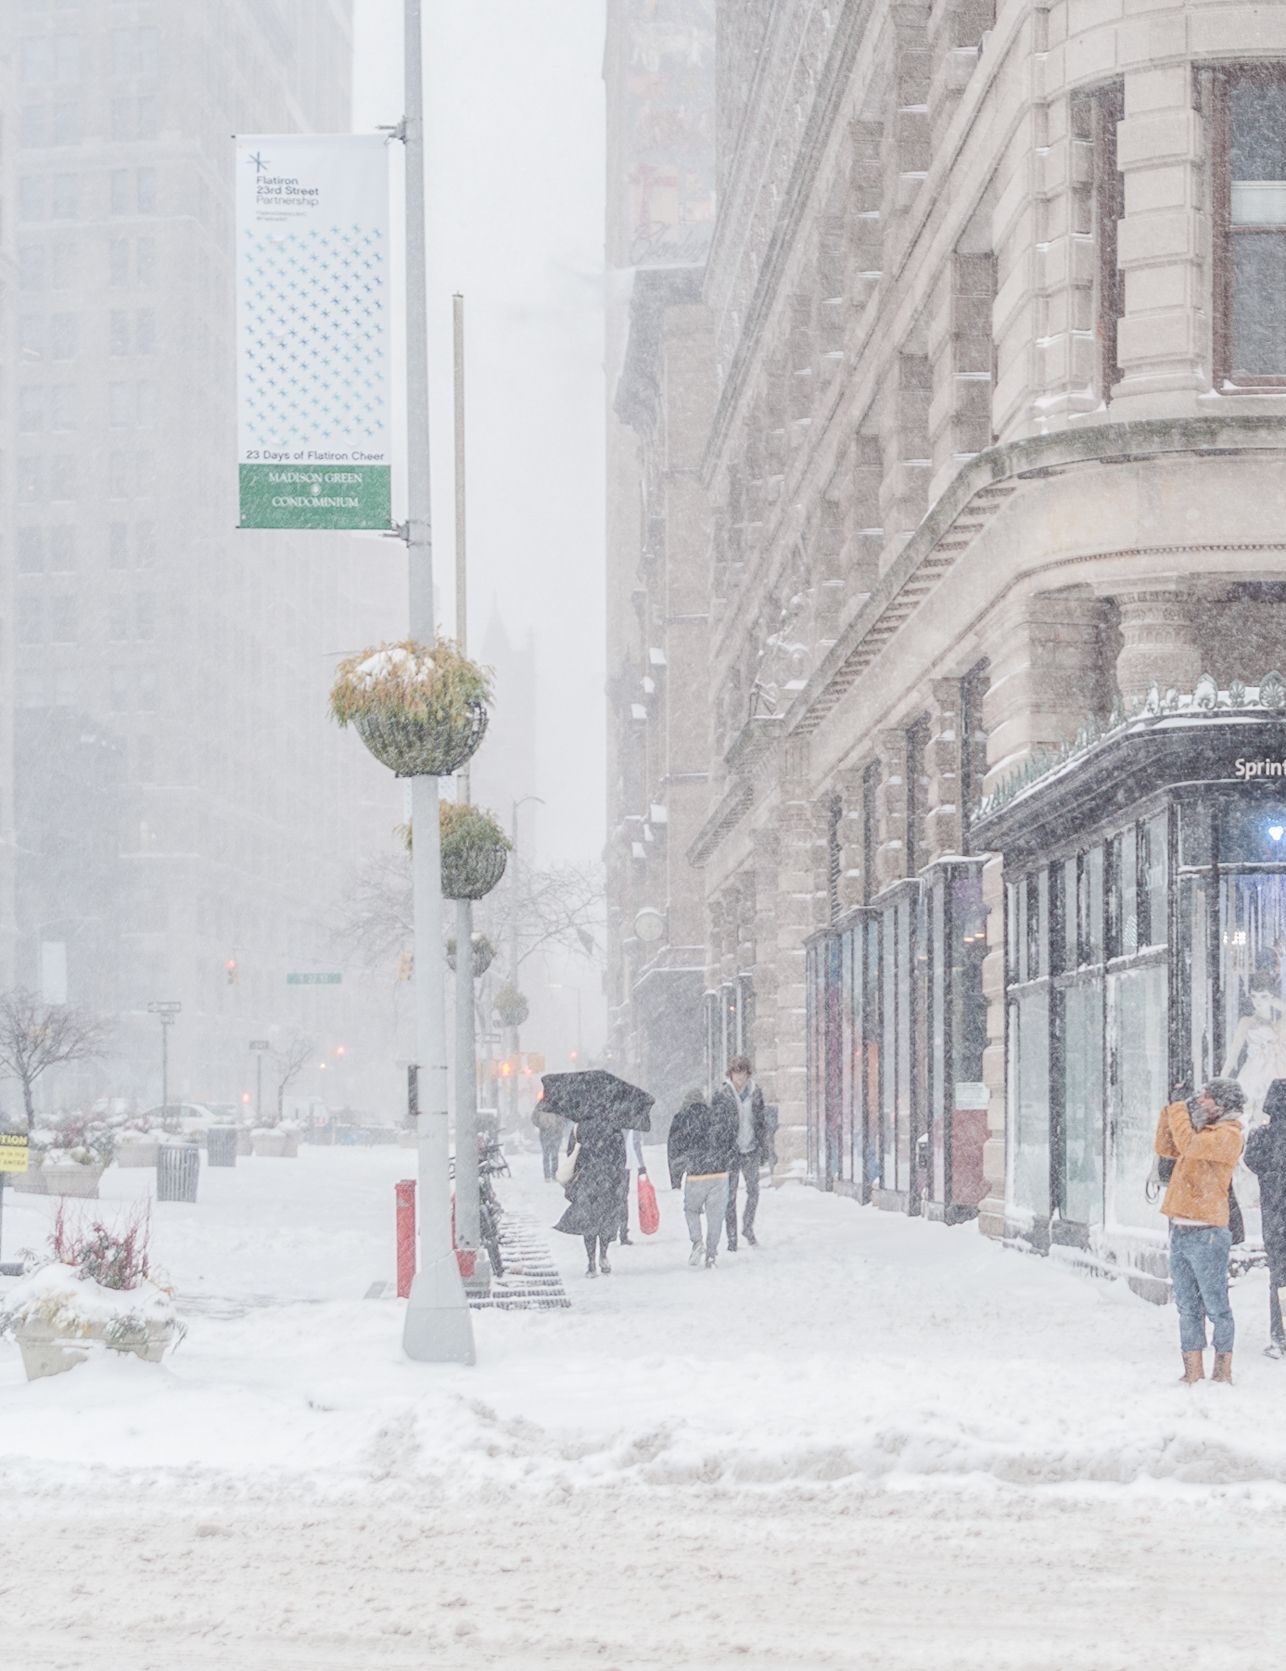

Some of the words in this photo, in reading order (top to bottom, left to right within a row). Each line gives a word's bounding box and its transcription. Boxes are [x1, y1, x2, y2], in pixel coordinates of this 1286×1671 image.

[256, 176, 298, 185] Flatiron
[256, 186, 282, 195] 23rd
[284, 186, 319, 196] Street
[256, 195, 319, 207] Partnership
[246, 450, 259, 460] 23
[263, 450, 290, 461] Days
[294, 450, 304, 460] of
[308, 450, 348, 460] Flatiron
[352, 450, 384, 460] Cheer
[269, 472, 323, 483] MADISON
[325, 472, 363, 483] GREEN
[271, 496, 359, 507] CONDOMINIUM
[0, 1136, 27, 1146] TION
